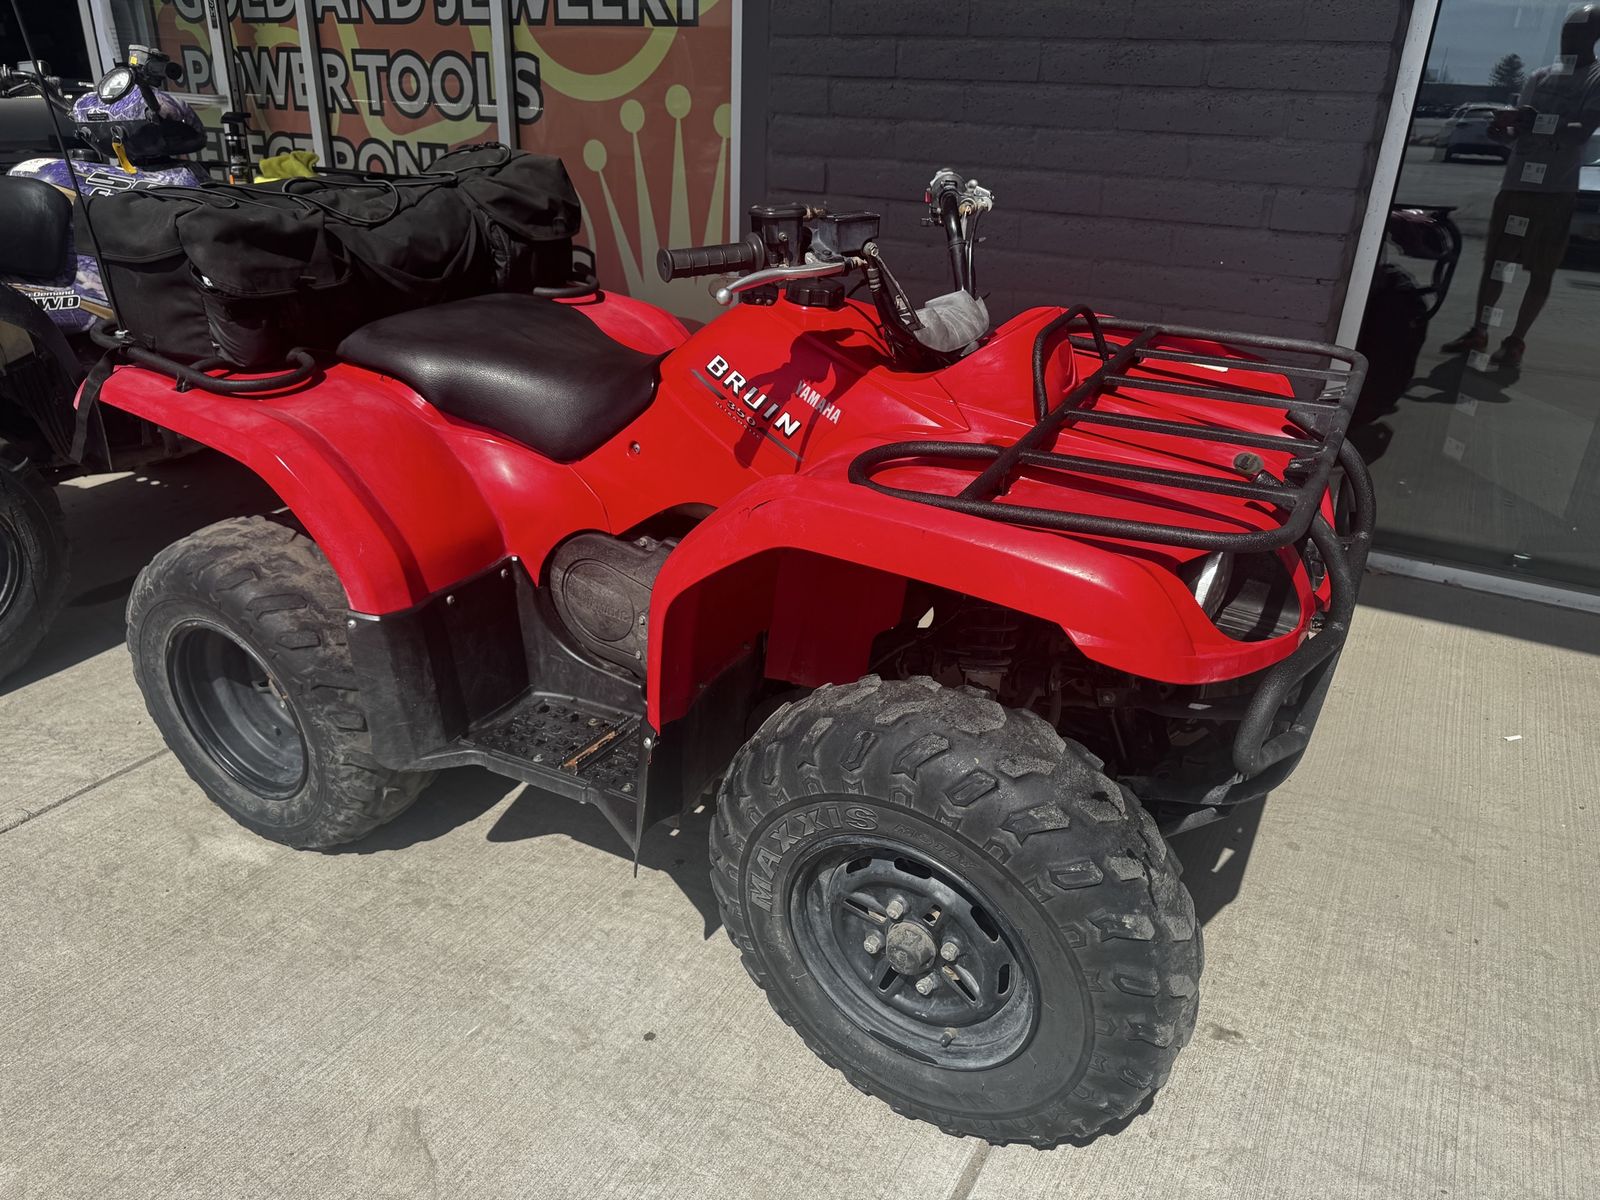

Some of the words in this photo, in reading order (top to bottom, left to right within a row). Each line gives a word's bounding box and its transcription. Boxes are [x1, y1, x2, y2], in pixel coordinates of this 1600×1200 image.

[351, 49, 543, 124] TOOLS
[705, 354, 802, 439] BRUIN
[726, 400, 758, 428] 350
[795, 379, 842, 425] YAMAHA
[750, 806, 879, 913] MAXXIS
